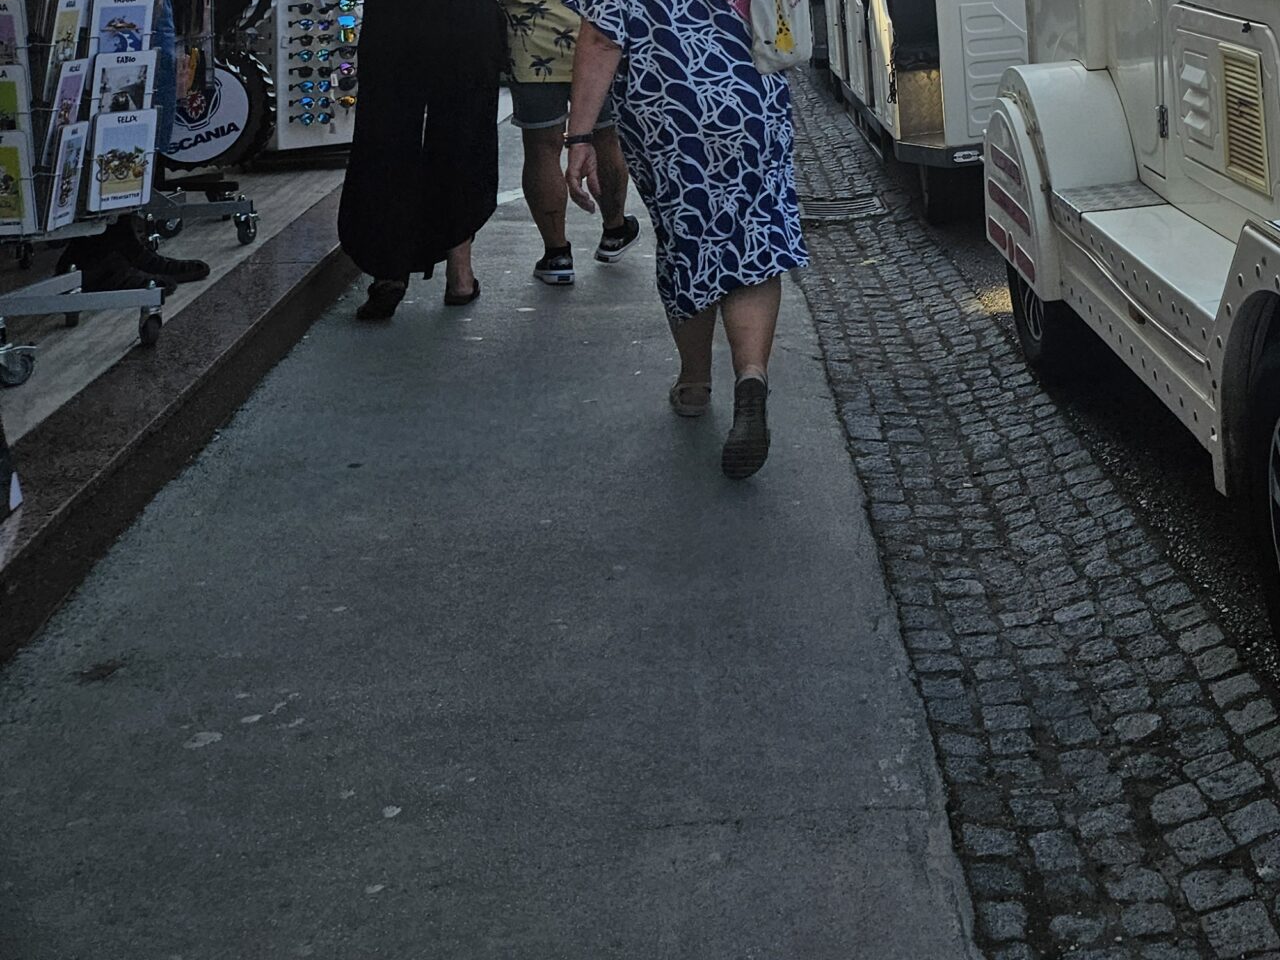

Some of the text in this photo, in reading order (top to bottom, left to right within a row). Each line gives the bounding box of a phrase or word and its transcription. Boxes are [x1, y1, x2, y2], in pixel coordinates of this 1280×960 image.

[116, 56, 136, 64] FABIO
[117, 115, 138, 125] FELIX
[167, 122, 240, 155] SCANIA
